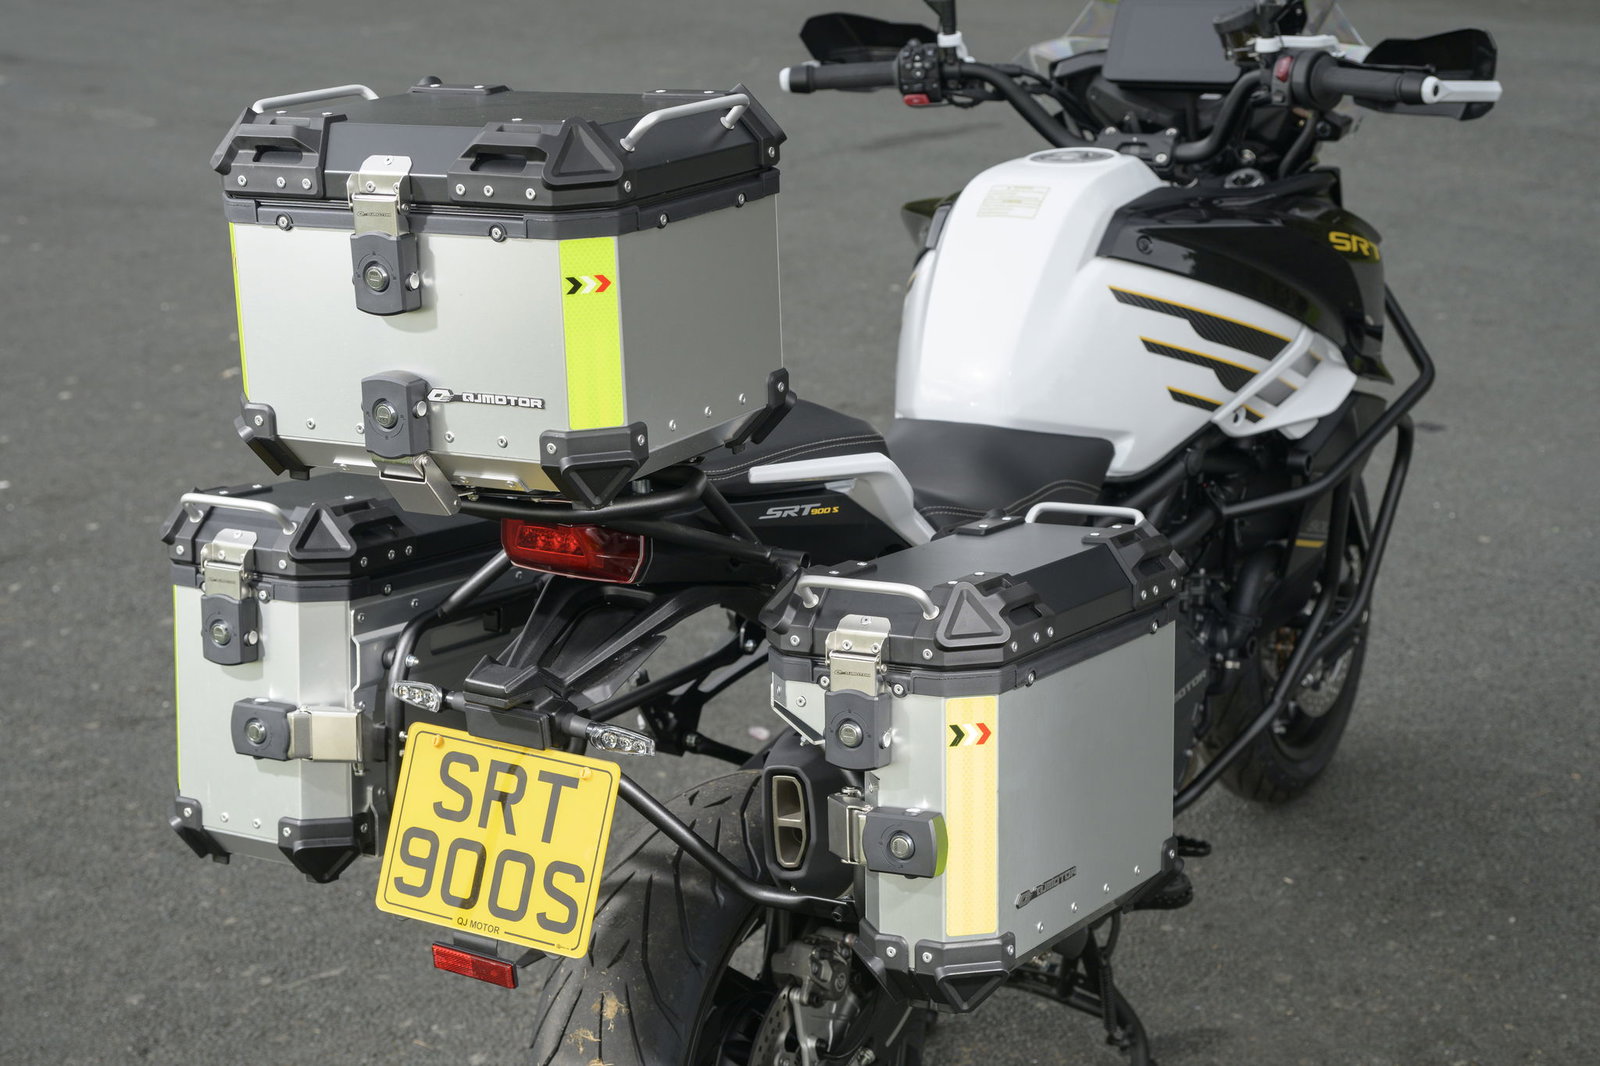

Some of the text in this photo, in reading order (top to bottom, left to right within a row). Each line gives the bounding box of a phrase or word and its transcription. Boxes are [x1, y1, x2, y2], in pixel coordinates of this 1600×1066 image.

[1328, 231, 1380, 260] SRT
[462, 392, 545, 409] QJMOTOR
[758, 503, 840, 520] SRT 900 S
[433, 751, 580, 844] SRT
[394, 827, 585, 935] 900S
[457, 917, 500, 934] QJ MOTOR
